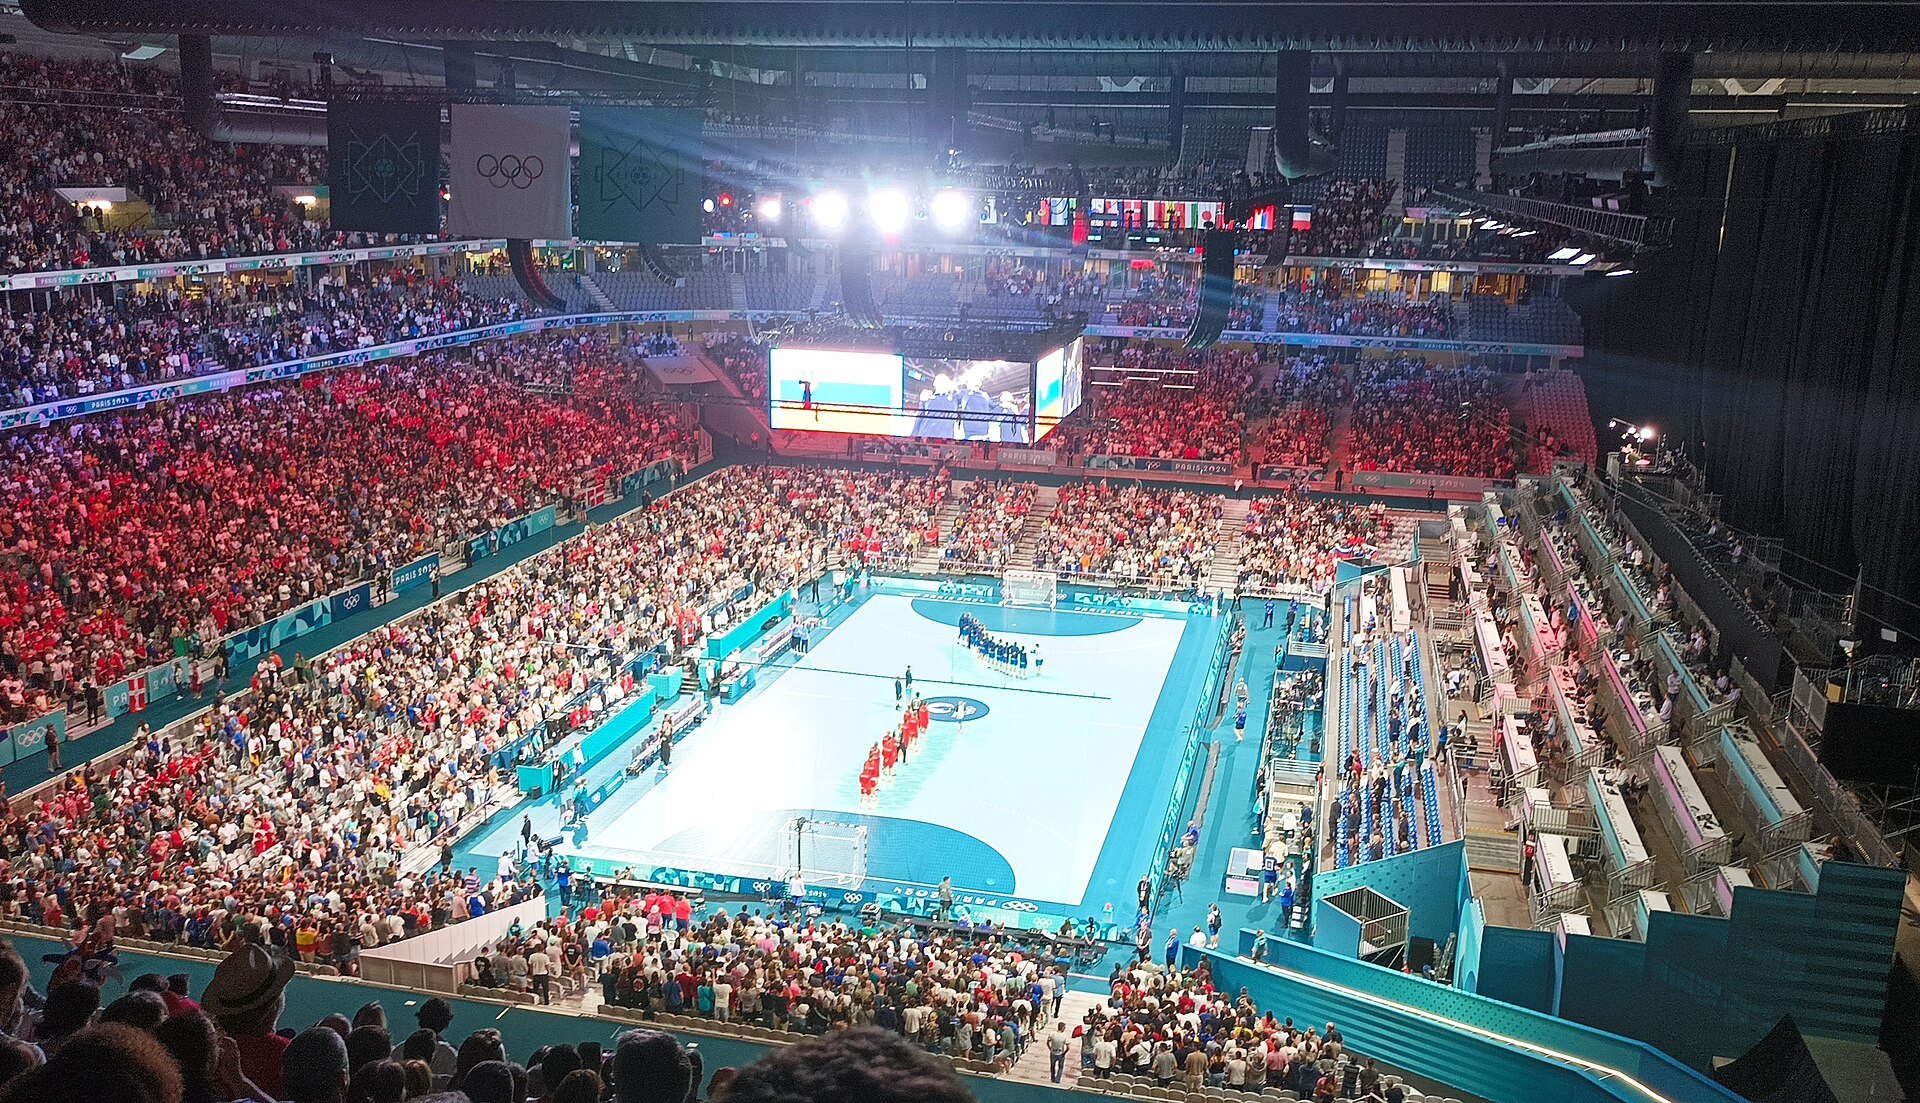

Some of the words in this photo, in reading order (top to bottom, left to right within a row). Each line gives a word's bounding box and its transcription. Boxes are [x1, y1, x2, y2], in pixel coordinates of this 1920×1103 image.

[91, 400, 112, 409] PARIS
[112, 396, 130, 406] 2024
[1003, 452, 1027, 461] PARIS
[1029, 454, 1052, 462] 2024
[1175, 463, 1201, 471] PARIS
[1203, 465, 1227, 473] 2024
[1409, 478, 1437, 486] PARIS
[1439, 479, 1465, 488] 2024
[395, 570, 417, 586] PARIS
[808, 889, 829, 898] 2024
[951, 893, 998, 907] PARI
